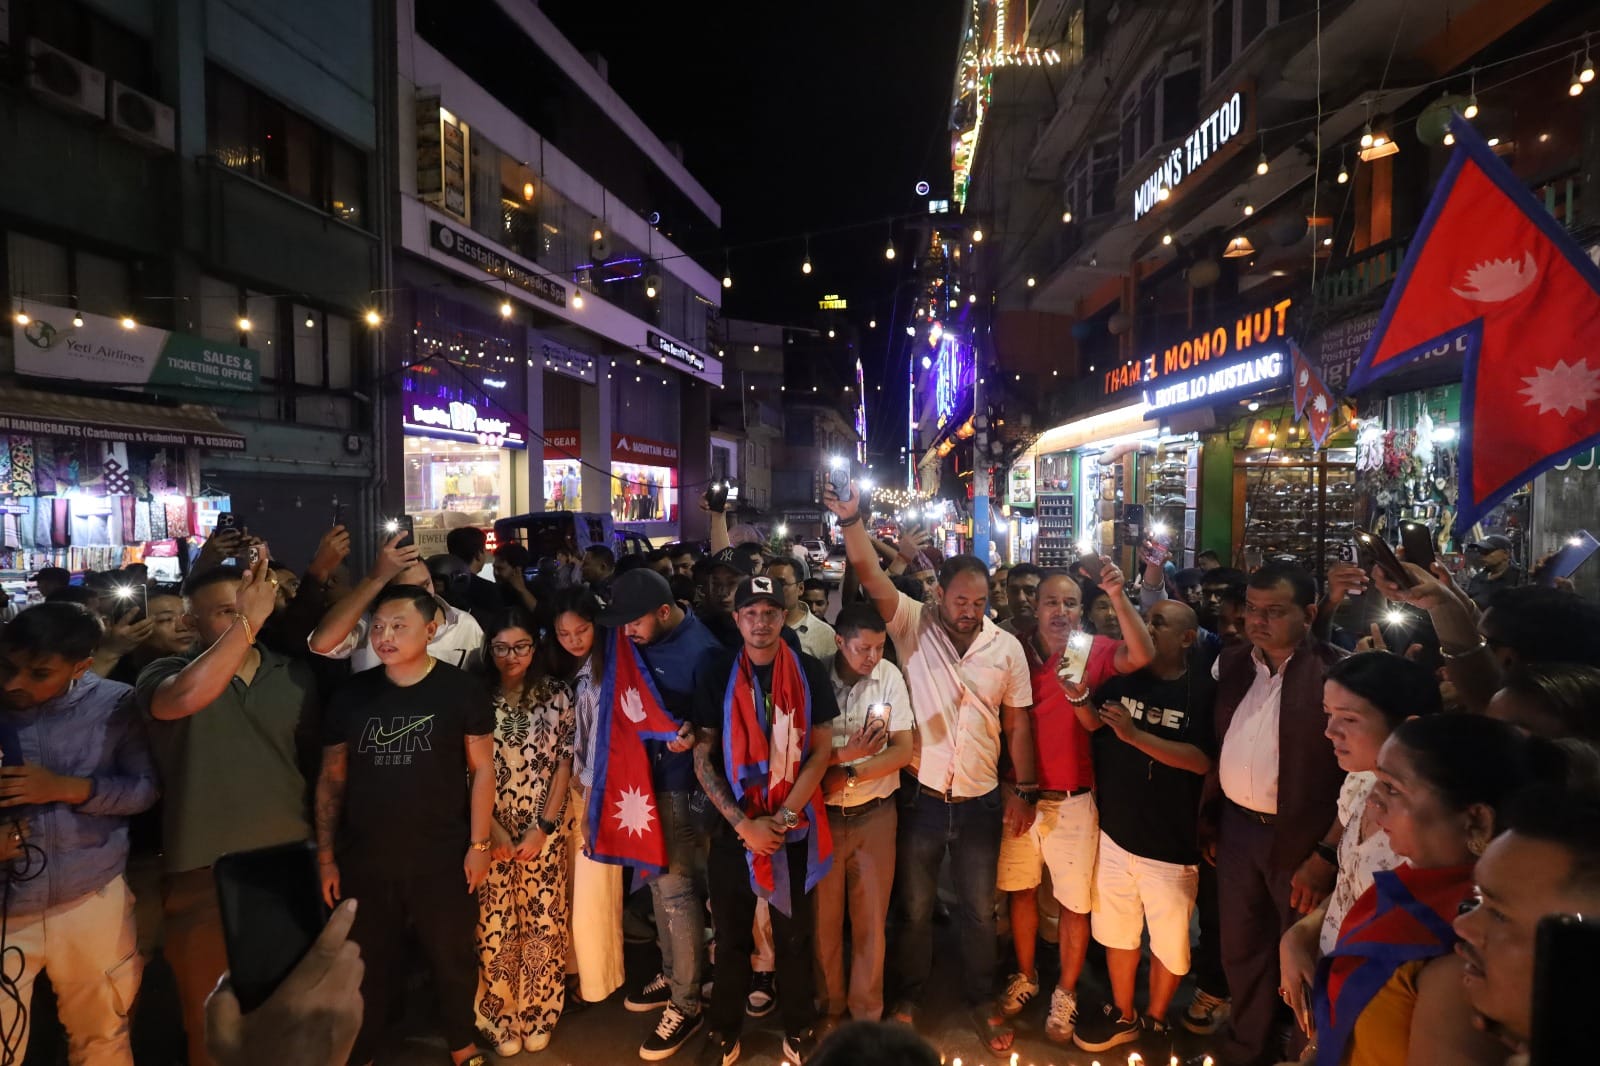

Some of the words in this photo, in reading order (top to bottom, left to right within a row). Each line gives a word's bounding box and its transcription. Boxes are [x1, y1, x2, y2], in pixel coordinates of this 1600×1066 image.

[1185, 92, 1241, 175] TATTOO
[456, 235, 501, 269] Ecstatic
[1164, 327, 1228, 375] MOMO
[1235, 298, 1292, 351] HUT
[67, 339, 92, 353] Yeti
[96, 346, 145, 363] Airlines
[203, 350, 241, 368] SALES
[243, 358, 253, 371] &
[167, 356, 219, 376] TICKETING
[221, 367, 253, 383] OFFICE
[1155, 381, 1190, 406] HOTEL
[1208, 353, 1281, 394] MUSTANG
[12, 418, 81, 437] HANDICRAFTS
[554, 437, 576, 447] GEAR
[358, 716, 433, 753] AIR
[374, 754, 413, 766] NIKE
